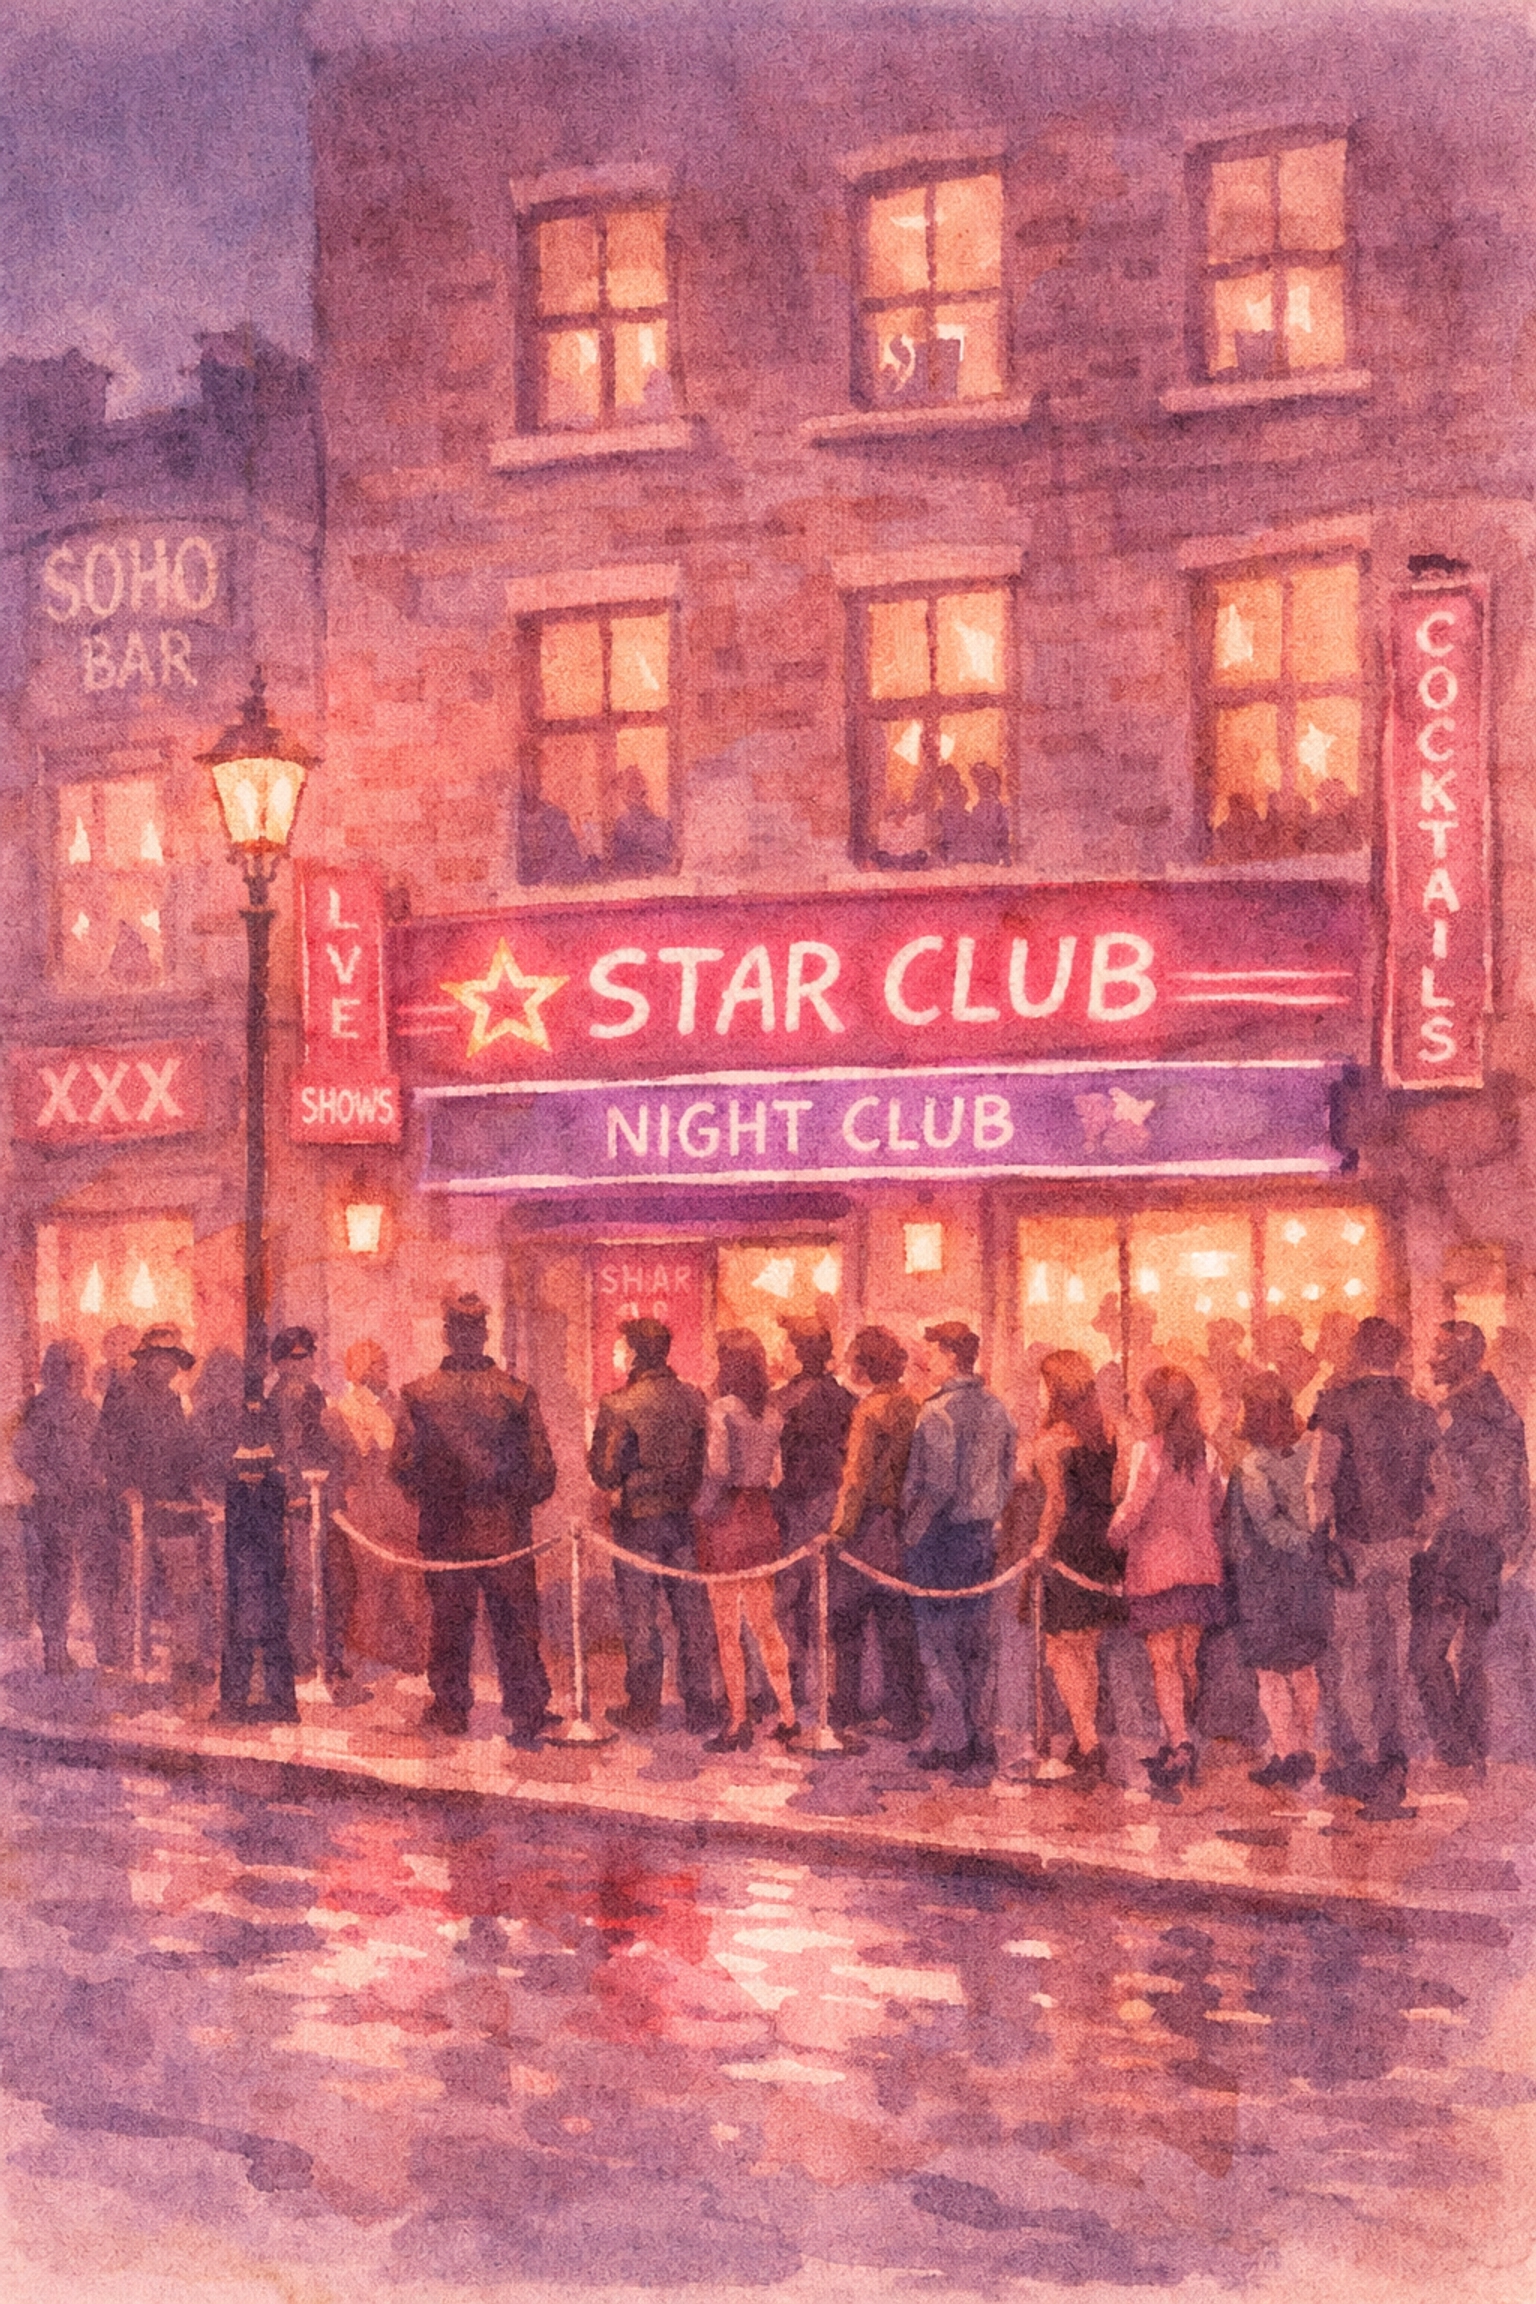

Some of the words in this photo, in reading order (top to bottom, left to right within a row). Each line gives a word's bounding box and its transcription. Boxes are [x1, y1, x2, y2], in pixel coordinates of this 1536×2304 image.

[42, 536, 219, 622] SOHO
[82, 629, 197, 692] BAR
[1415, 611, 1460, 1063] COCKTAILS
[589, 941, 845, 1039] STAR
[884, 932, 1157, 1026] CLUB
[37, 1058, 184, 1127] XXX
[301, 1086, 394, 1125] SHOWS
[606, 1101, 813, 1160] NIGHT
[842, 1094, 1014, 1153] CLUB
